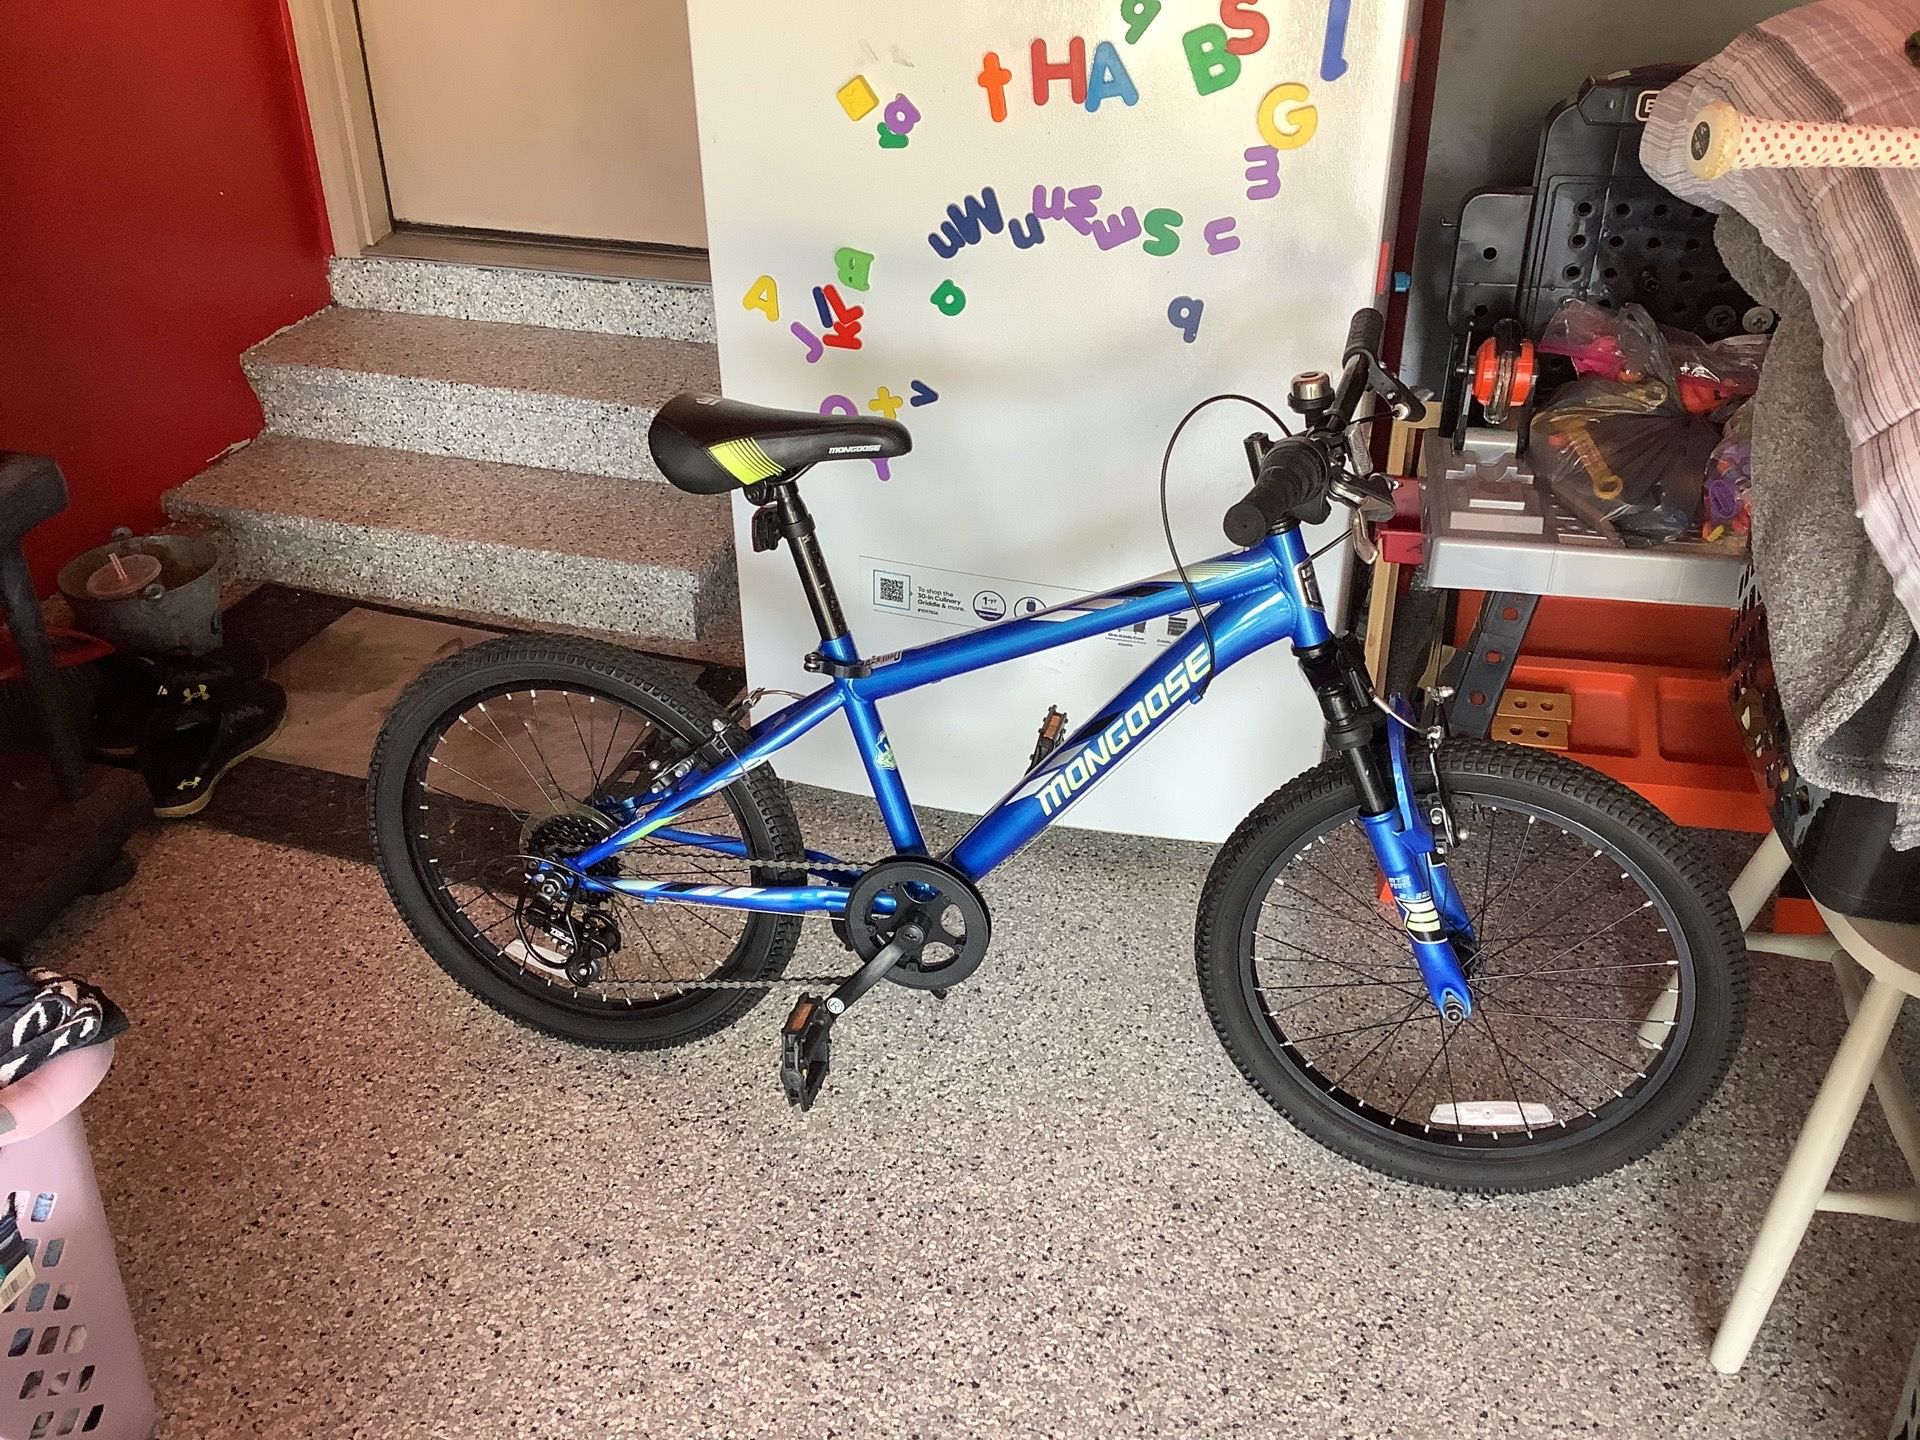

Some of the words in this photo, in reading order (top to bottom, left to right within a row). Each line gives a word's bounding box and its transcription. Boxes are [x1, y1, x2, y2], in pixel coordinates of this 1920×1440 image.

[1256, 82, 1318, 150] G
[742, 275, 780, 321] A
[828, 444, 881, 455] MONGOOSE
[926, 588, 942, 596] shop
[943, 590, 954, 598] the
[934, 595, 961, 605] Culinary
[1036, 642, 1213, 817] MONGOOSE
